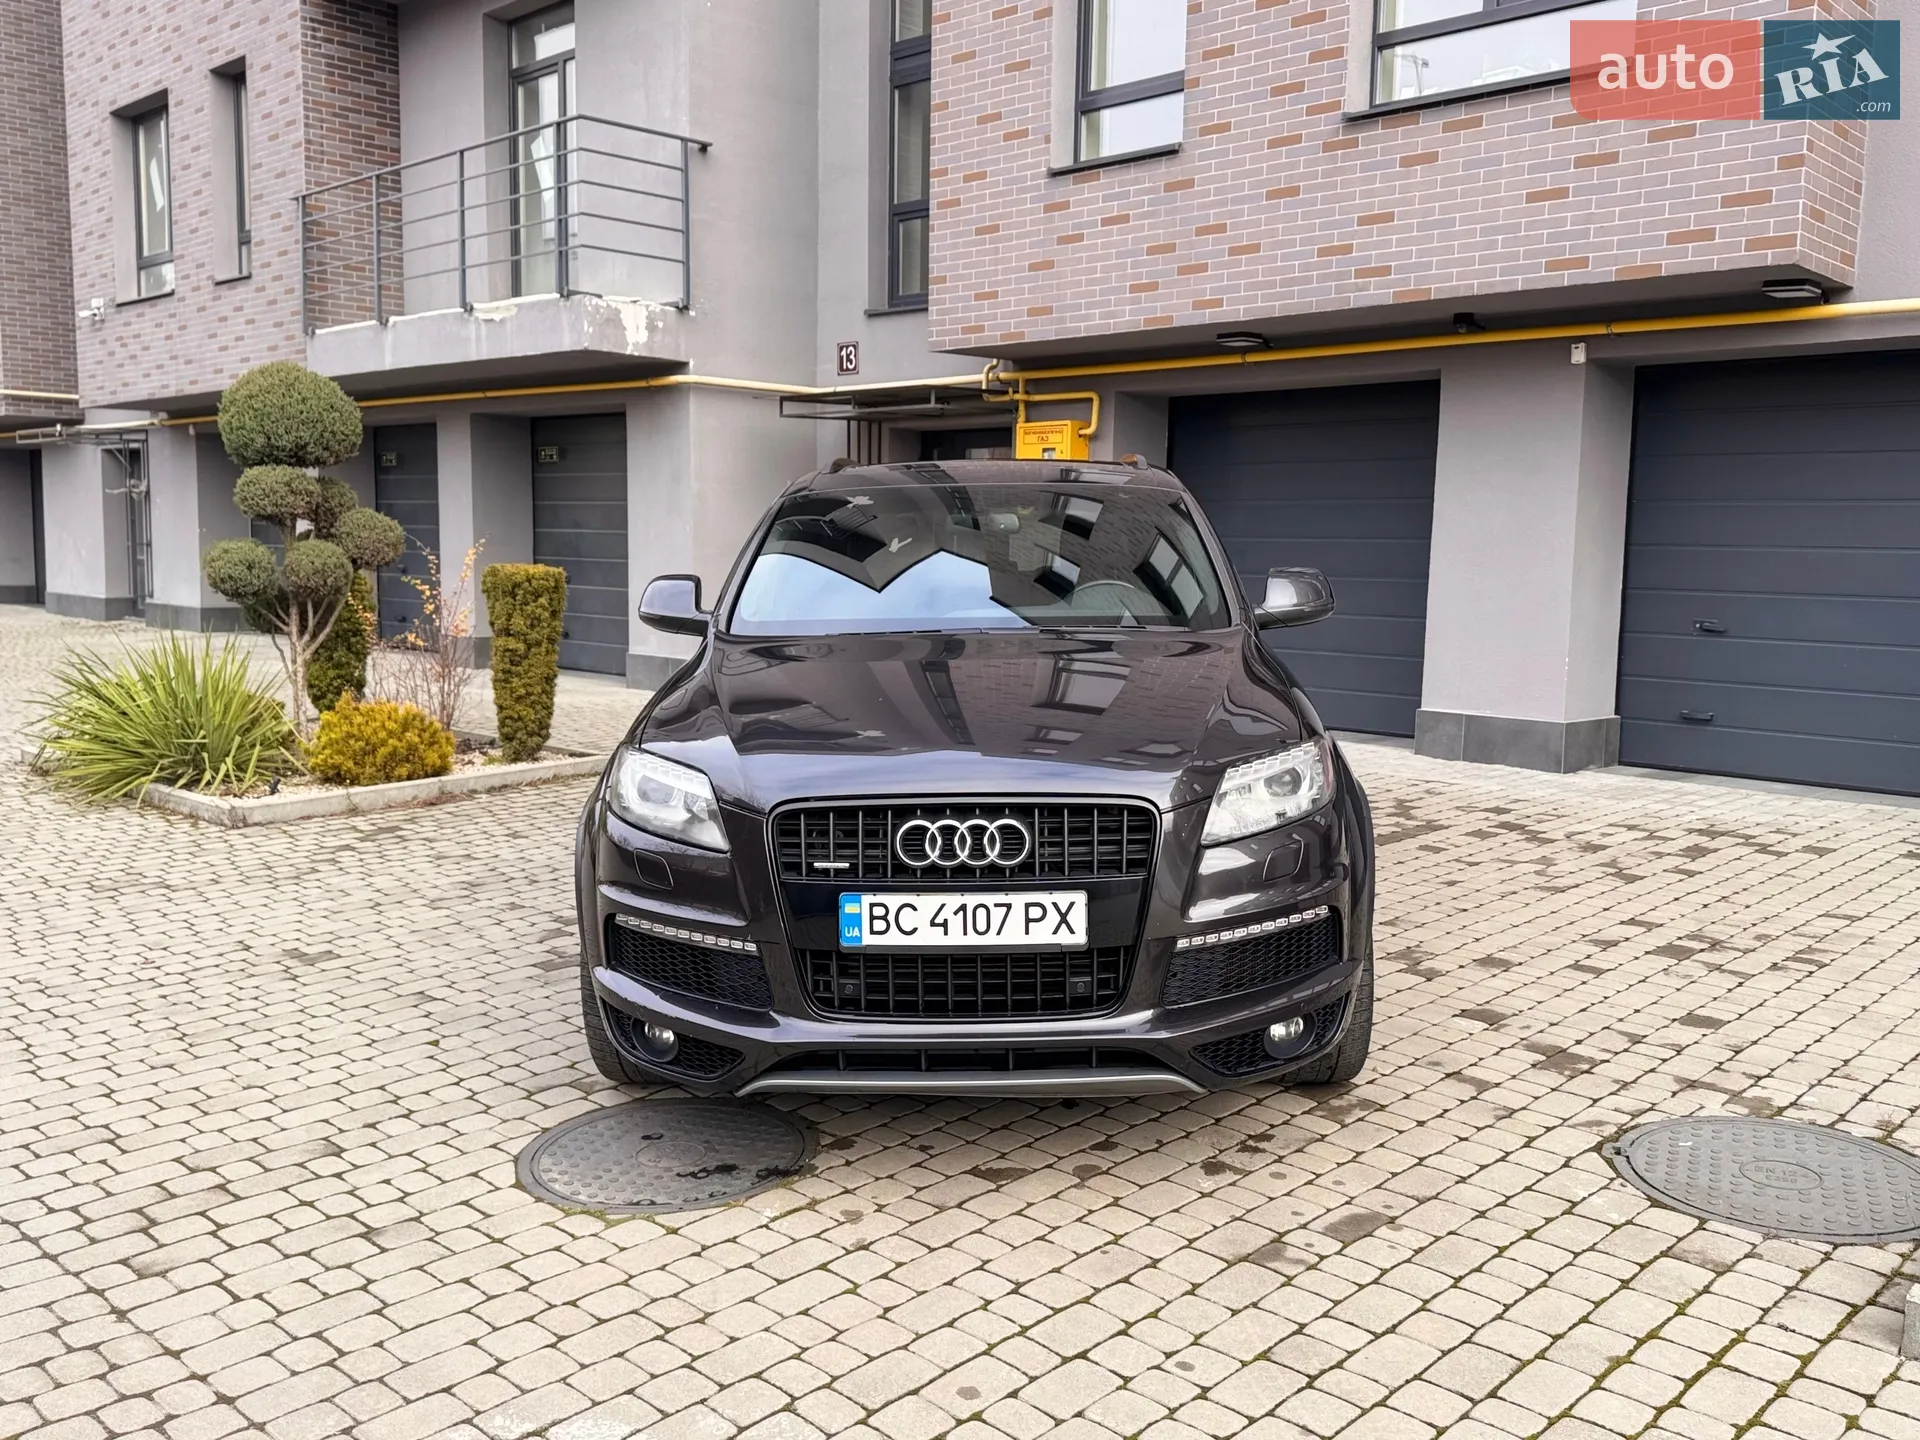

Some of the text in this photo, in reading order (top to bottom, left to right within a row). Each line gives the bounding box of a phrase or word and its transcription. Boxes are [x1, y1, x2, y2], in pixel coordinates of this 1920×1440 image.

[840, 346, 856, 370] 13
[869, 901, 1077, 936] BC 4107 PX
[844, 926, 861, 938] UA
